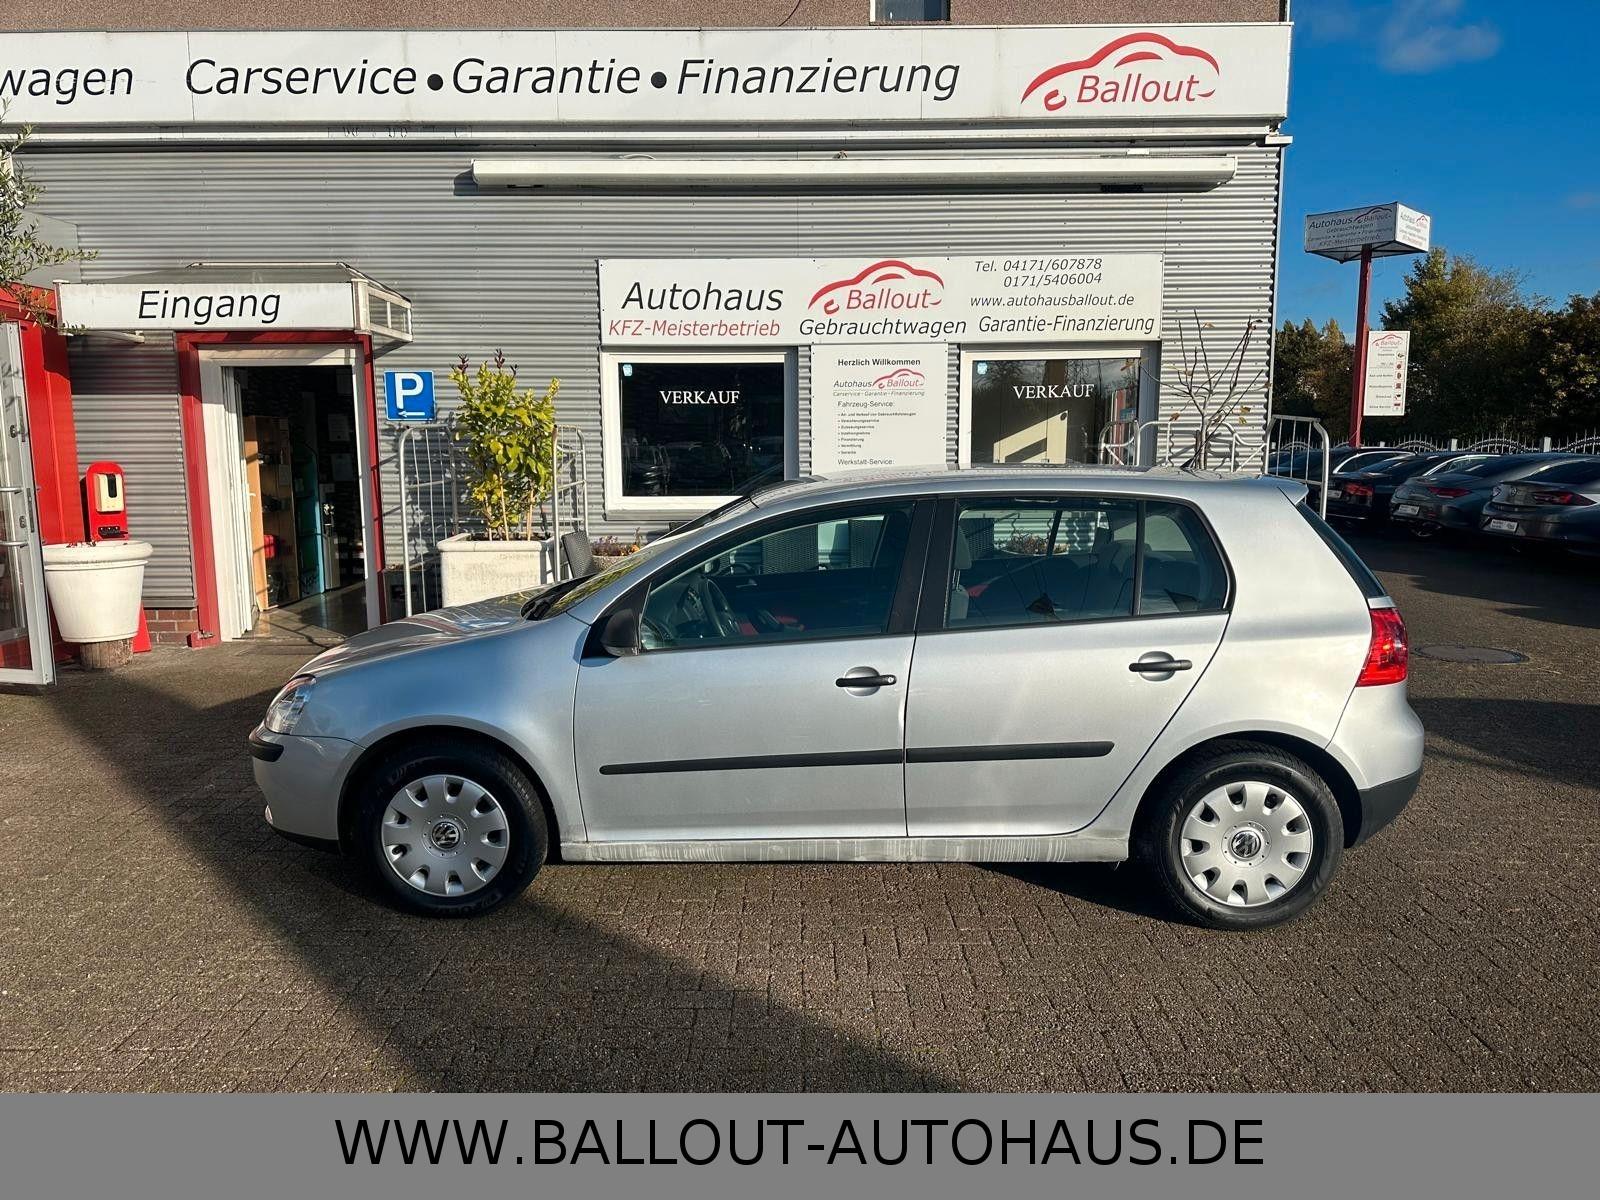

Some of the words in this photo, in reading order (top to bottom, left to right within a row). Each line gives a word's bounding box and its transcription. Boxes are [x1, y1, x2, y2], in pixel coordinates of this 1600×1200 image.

[0, 67, 134, 105] wagen
[186, 58, 417, 96] Carservice
[452, 57, 641, 94] Garantie
[677, 58, 961, 101] Finanzierung
[1076, 73, 1200, 103] Ballout
[1309, 218, 1352, 231] Autohaus
[975, 260, 998, 273] Tel.
[1003, 258, 1103, 273] 04171/607878
[1003, 272, 1103, 288] 0171/5406004
[621, 281, 784, 312] Autohaus
[846, 287, 932, 311] Ballout
[970, 293, 1135, 308] www.autohausballout.de
[138, 289, 281, 325] Eingang
[608, 319, 781, 337] KFZ-Meisterbetrieb
[799, 317, 967, 338] Gebrauchtwagen
[979, 315, 1155, 335] Garantie-Finanzierung
[838, 358, 870, 366] Herzlich
[872, 358, 921, 366] Willkommen
[396, 373, 424, 409] P
[834, 380, 872, 388] Autohaus
[887, 379, 919, 388] Ballout
[1013, 384, 1095, 400] VERKAUF
[659, 390, 741, 405] VERKAUF
